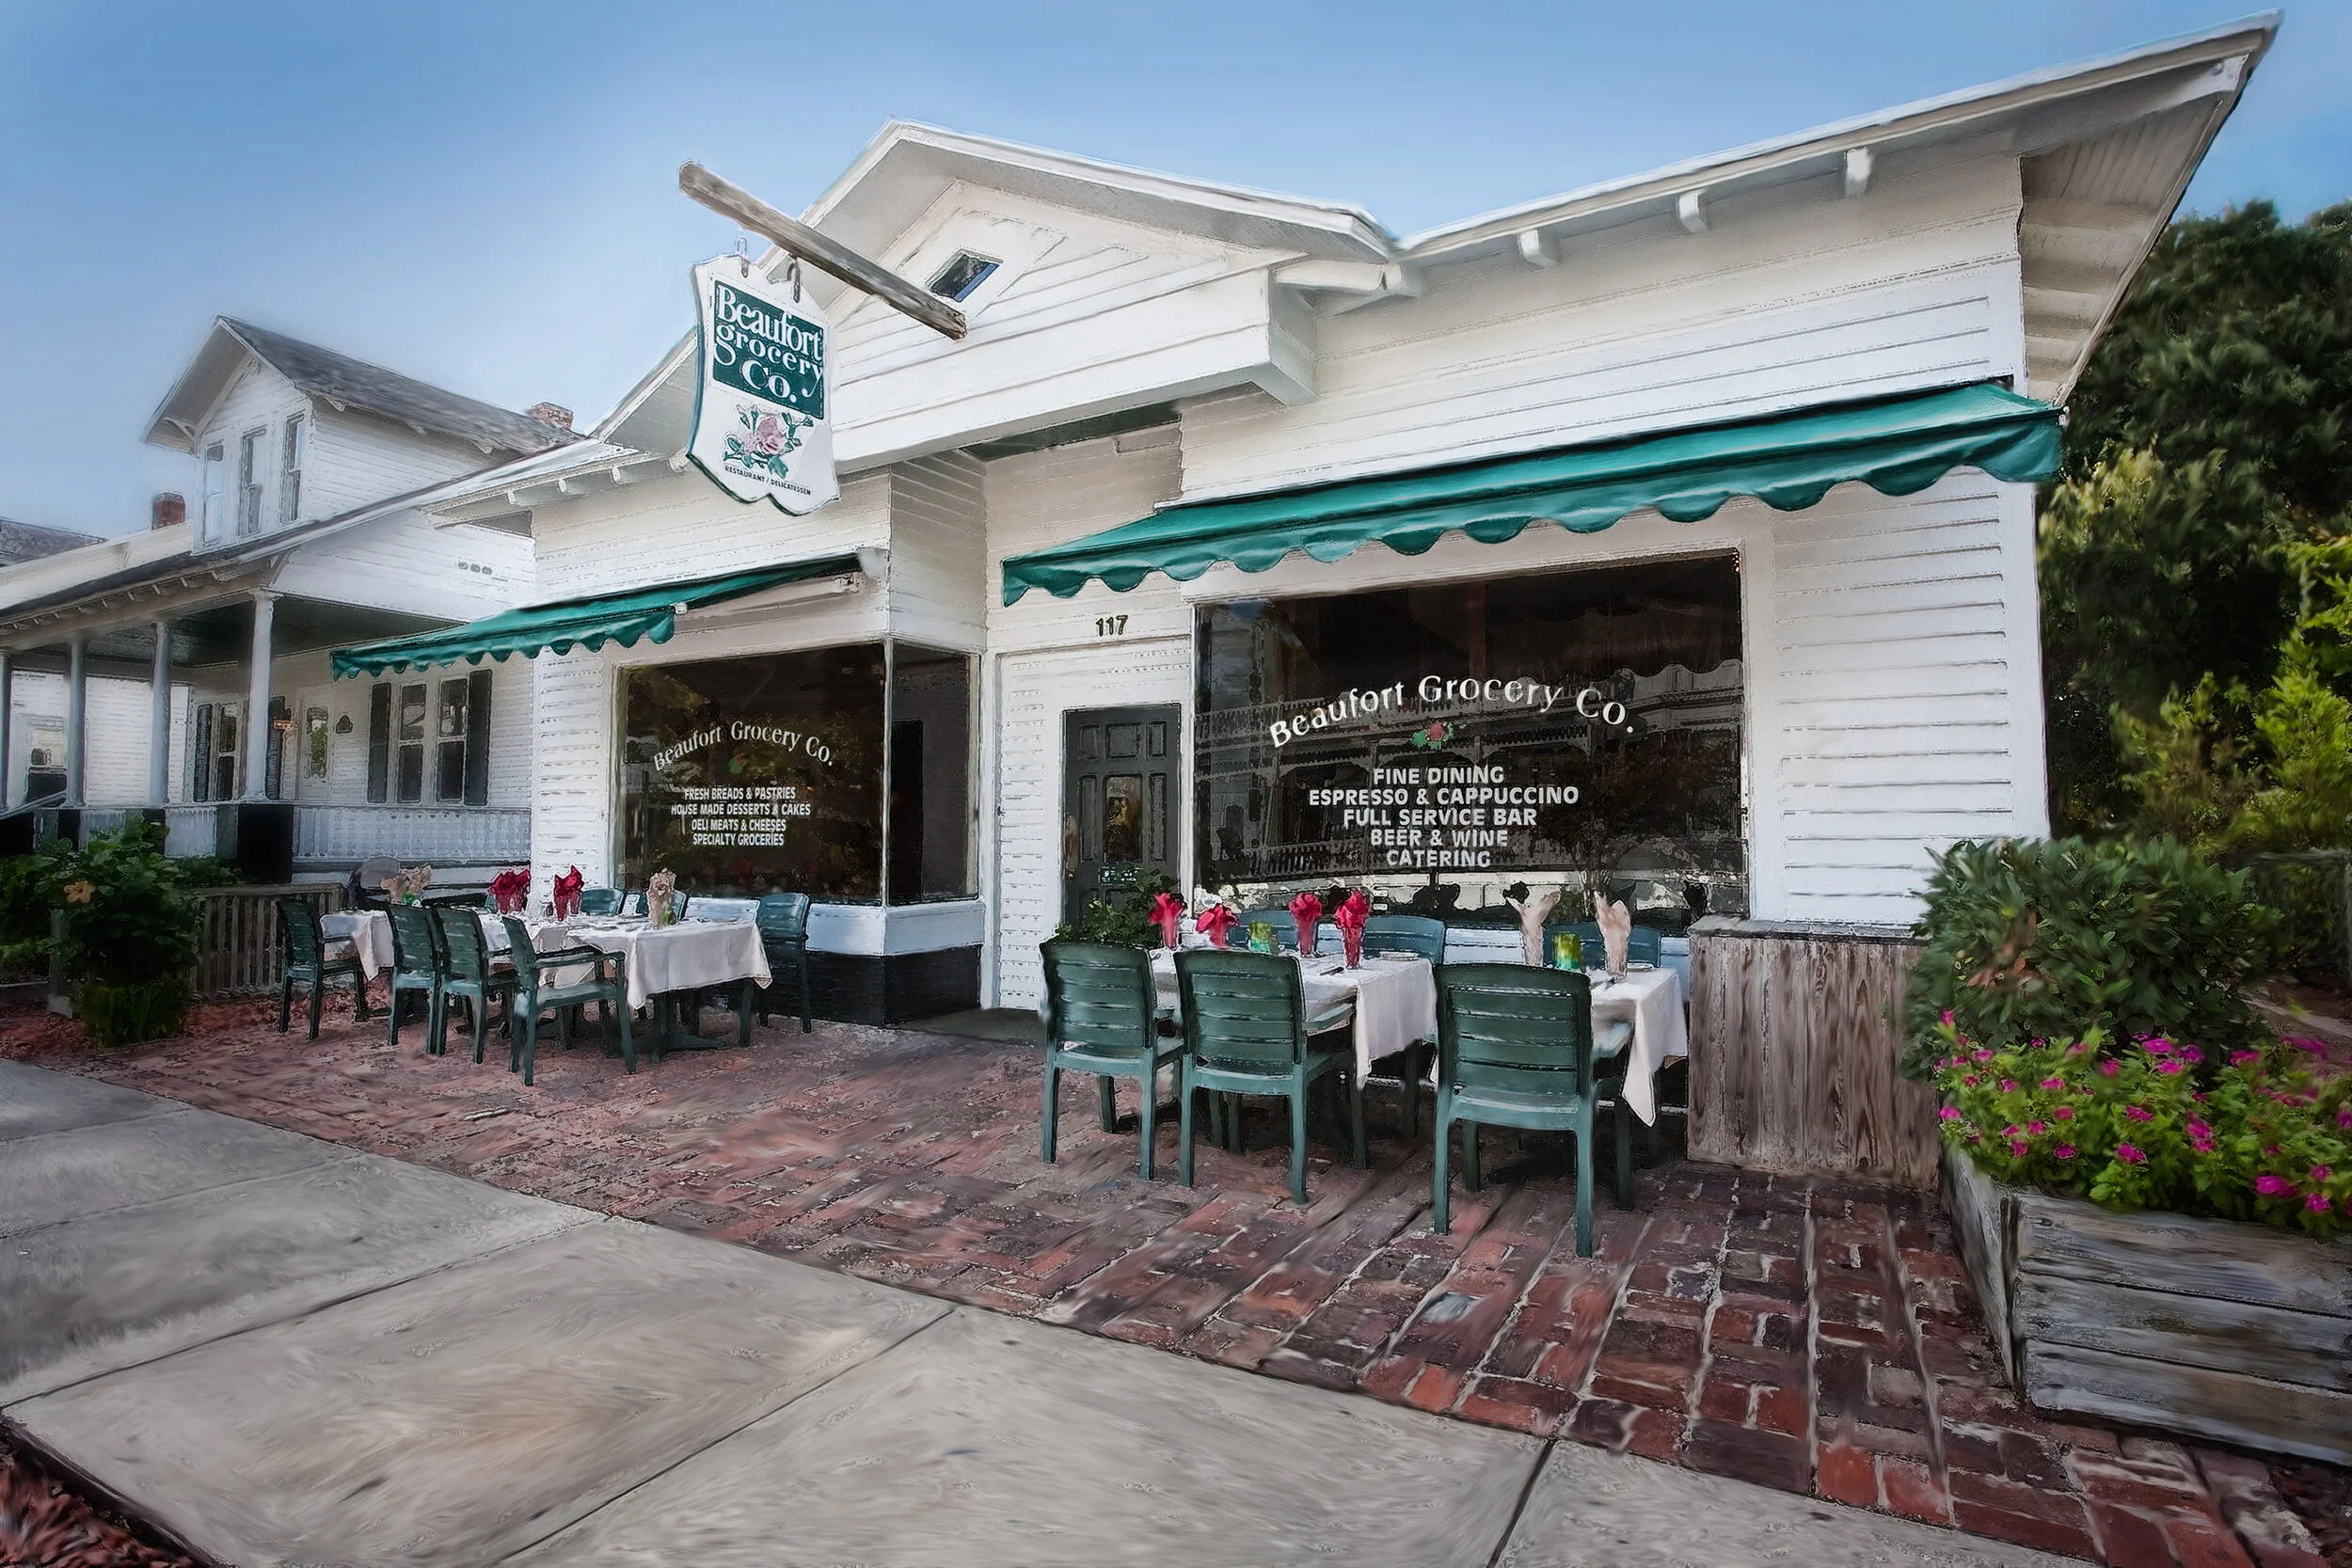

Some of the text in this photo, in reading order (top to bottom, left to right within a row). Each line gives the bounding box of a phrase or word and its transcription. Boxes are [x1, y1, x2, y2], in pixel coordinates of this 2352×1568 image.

[718, 285, 821, 361] Beaufort
[742, 359, 797, 403] Co.
[724, 466, 765, 483] RESTAURANT
[771, 479, 811, 496] DELICATESSEN
[1095, 614, 1128, 637] 117
[1269, 674, 1635, 749] Beaufort Grocery Co.
[653, 721, 833, 771] Beaufort Grocery Co.
[1374, 766, 1504, 784] FINE DINING
[685, 786, 796, 800] FRESH BREADS & PASTRIES
[1309, 786, 1579, 806] ESPRESSO & CAPPUCCINO
[671, 802, 811, 816] HOUSE MADE DESSERTS & CAKES
[1343, 808, 1537, 828] FULL SERVICE BAR
[691, 818, 787, 832] DELI MEATS & CHEESES
[692, 833, 785, 846] SPECIALTY GROCERIES
[1371, 829, 1508, 847] BEER & WINE
[1387, 848, 1491, 867] CATERING
